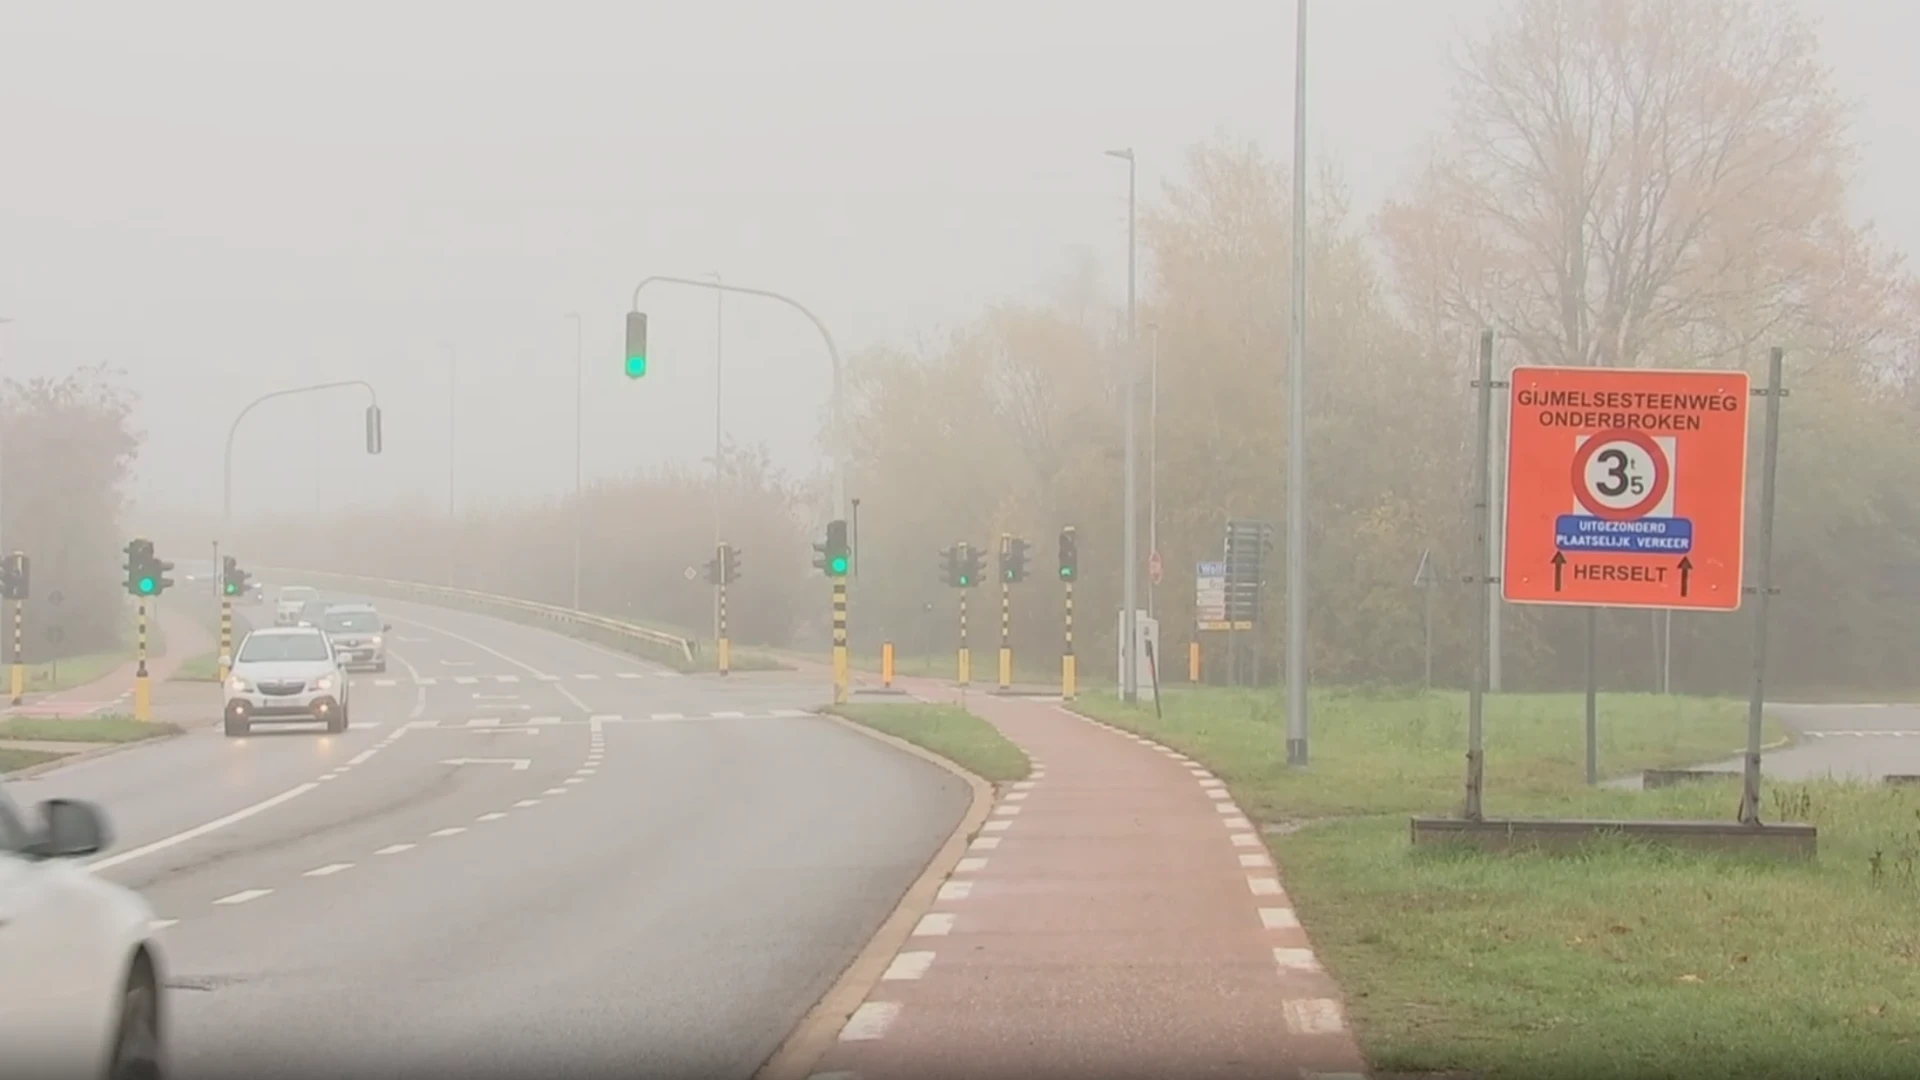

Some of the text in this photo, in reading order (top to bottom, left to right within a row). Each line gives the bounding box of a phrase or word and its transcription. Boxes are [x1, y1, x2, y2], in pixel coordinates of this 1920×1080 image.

[1517, 389, 1738, 411] GIJMELSESTEENWEG
[1538, 411, 1700, 430] ONDERBROKEN
[1579, 520, 1666, 534] UITGEZONDERD
[1556, 534, 1690, 549] PLAATSELIJK VERKEER
[1574, 564, 1667, 582] HERSELT
